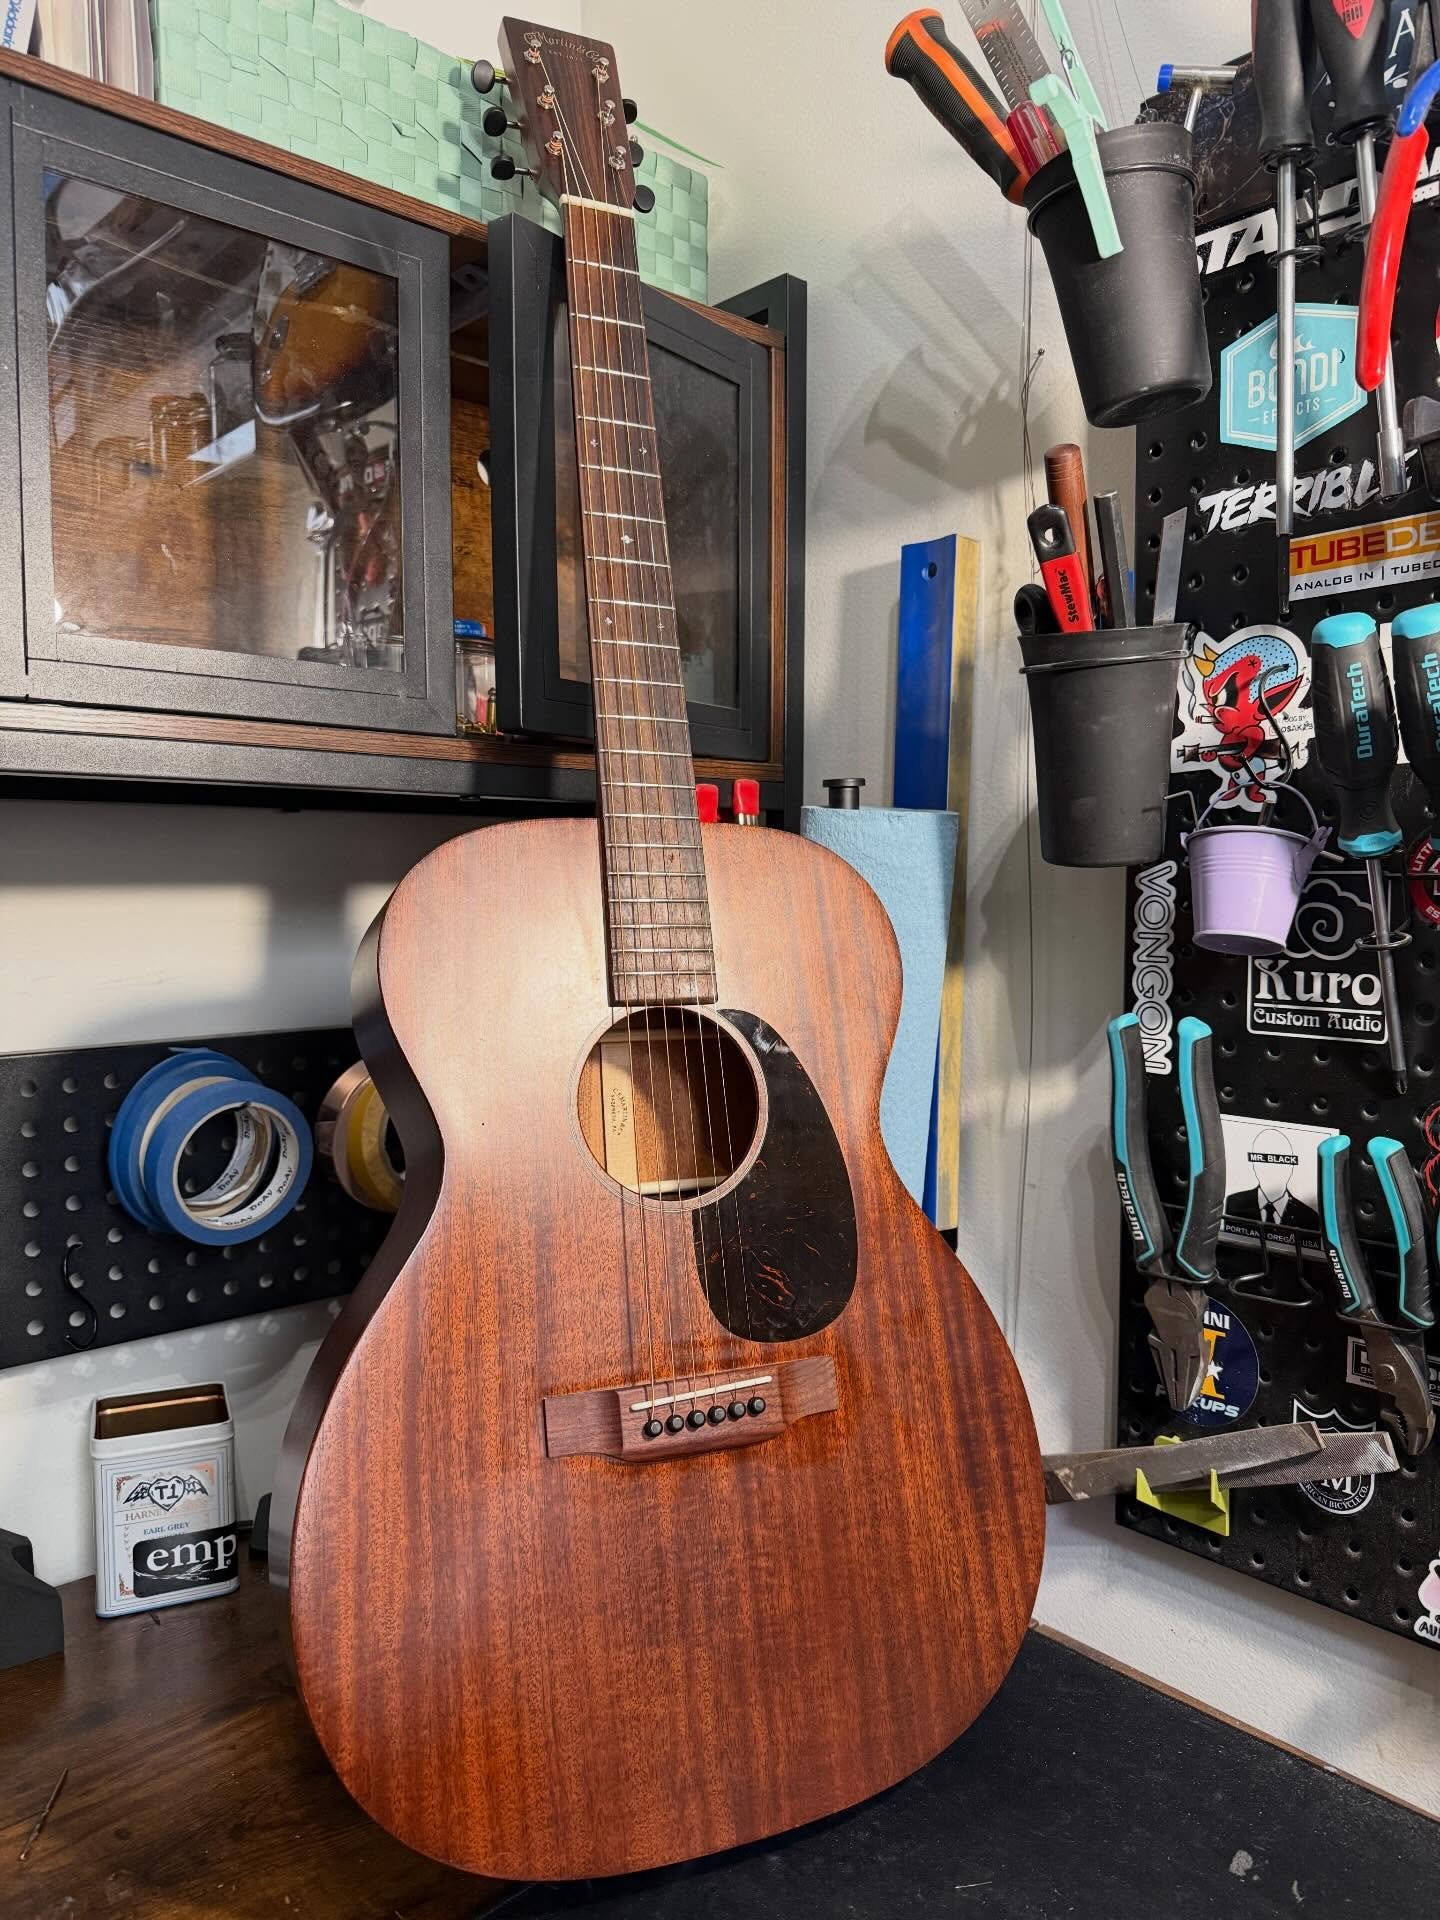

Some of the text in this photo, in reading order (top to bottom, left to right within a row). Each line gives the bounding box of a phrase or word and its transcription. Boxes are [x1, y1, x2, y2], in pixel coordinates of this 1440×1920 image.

[1294, 574, 1353, 593] ANALOG
[1359, 570, 1374, 582] IN
[1058, 568, 1080, 623] StewMac
[1253, 959, 1382, 1006] Kuro
[1253, 1008, 1382, 1033] Custom Audio
[1267, 1155, 1297, 1164] BLACK
[1329, 1495, 1361, 1510] BICYCLE
[143, 1521, 190, 1536] EARL GREY
